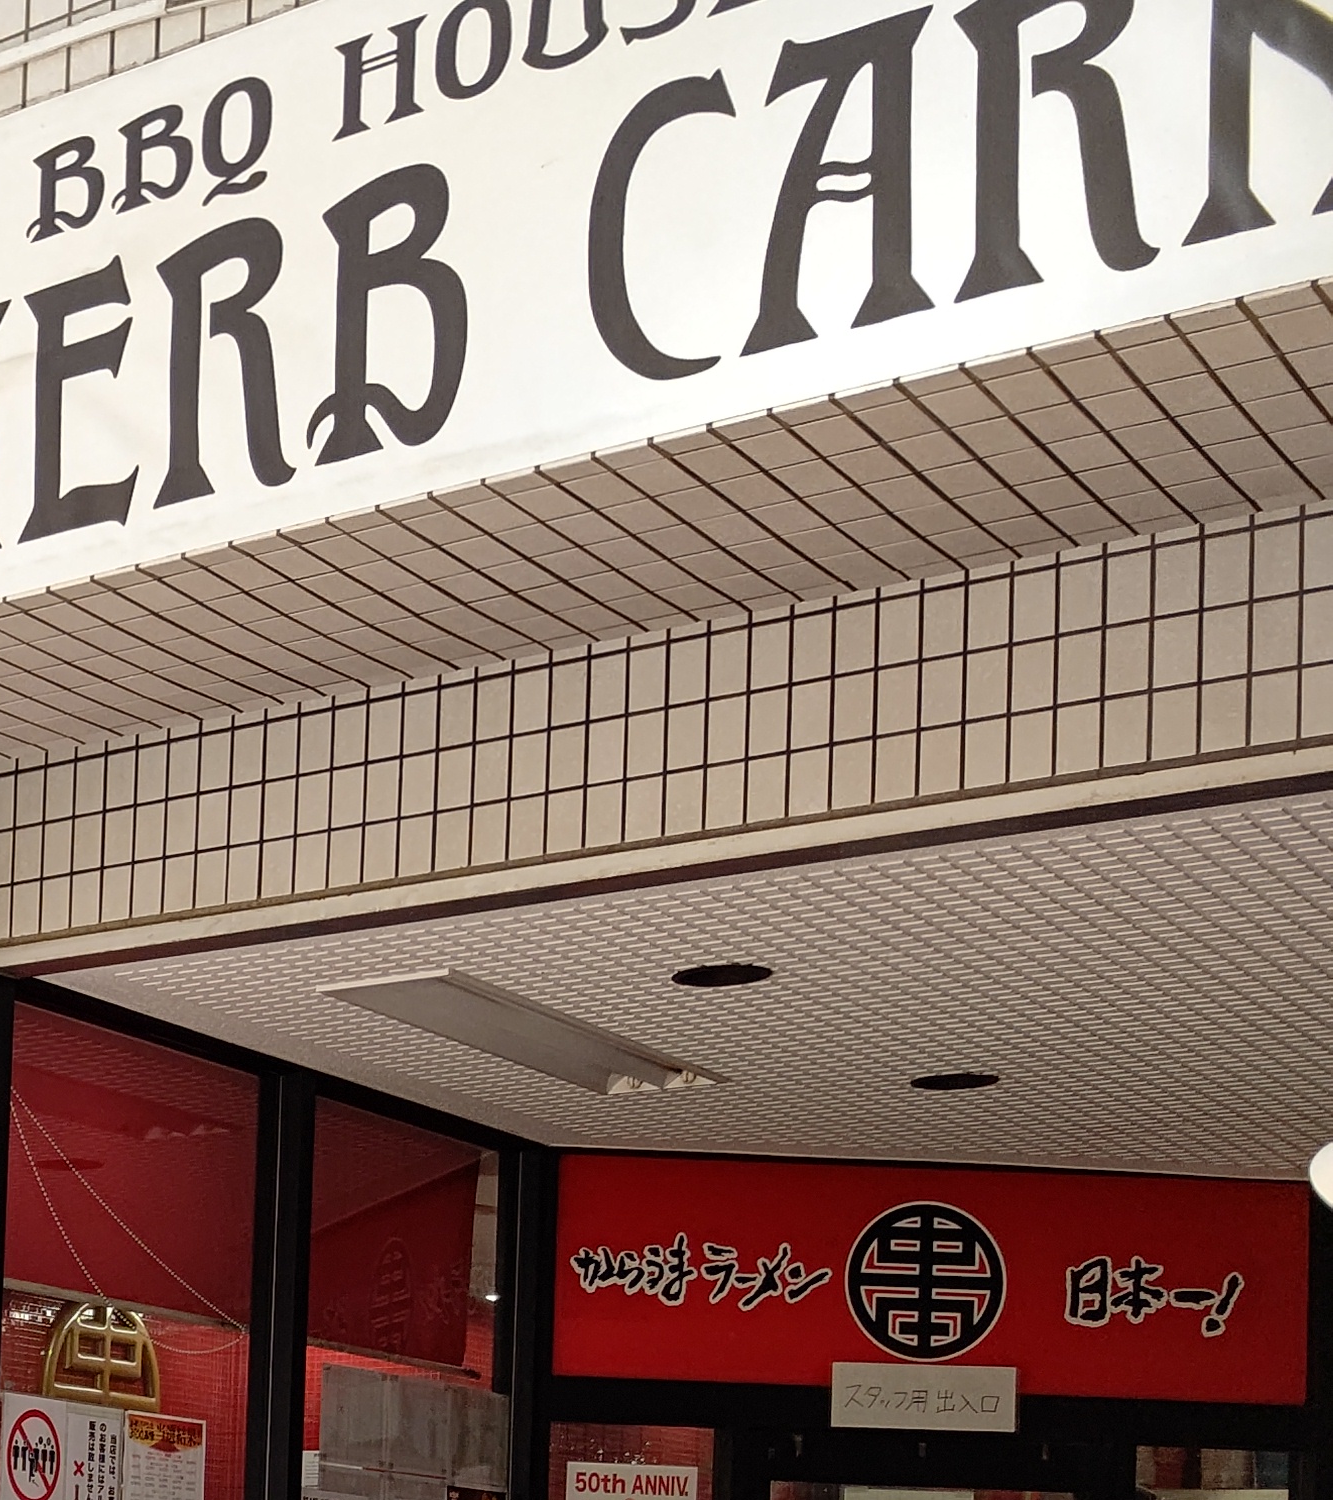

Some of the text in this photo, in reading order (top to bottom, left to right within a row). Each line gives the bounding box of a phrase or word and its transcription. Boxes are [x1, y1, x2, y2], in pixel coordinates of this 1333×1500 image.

[26, 0, 733, 243] BBQ HOUS
[1064, 1255, 1245, 1336] 日本一!
[843, 1380, 1002, 1416] スタッフ用出入口
[574, 1472, 690, 1497] 50th ANNIV.
